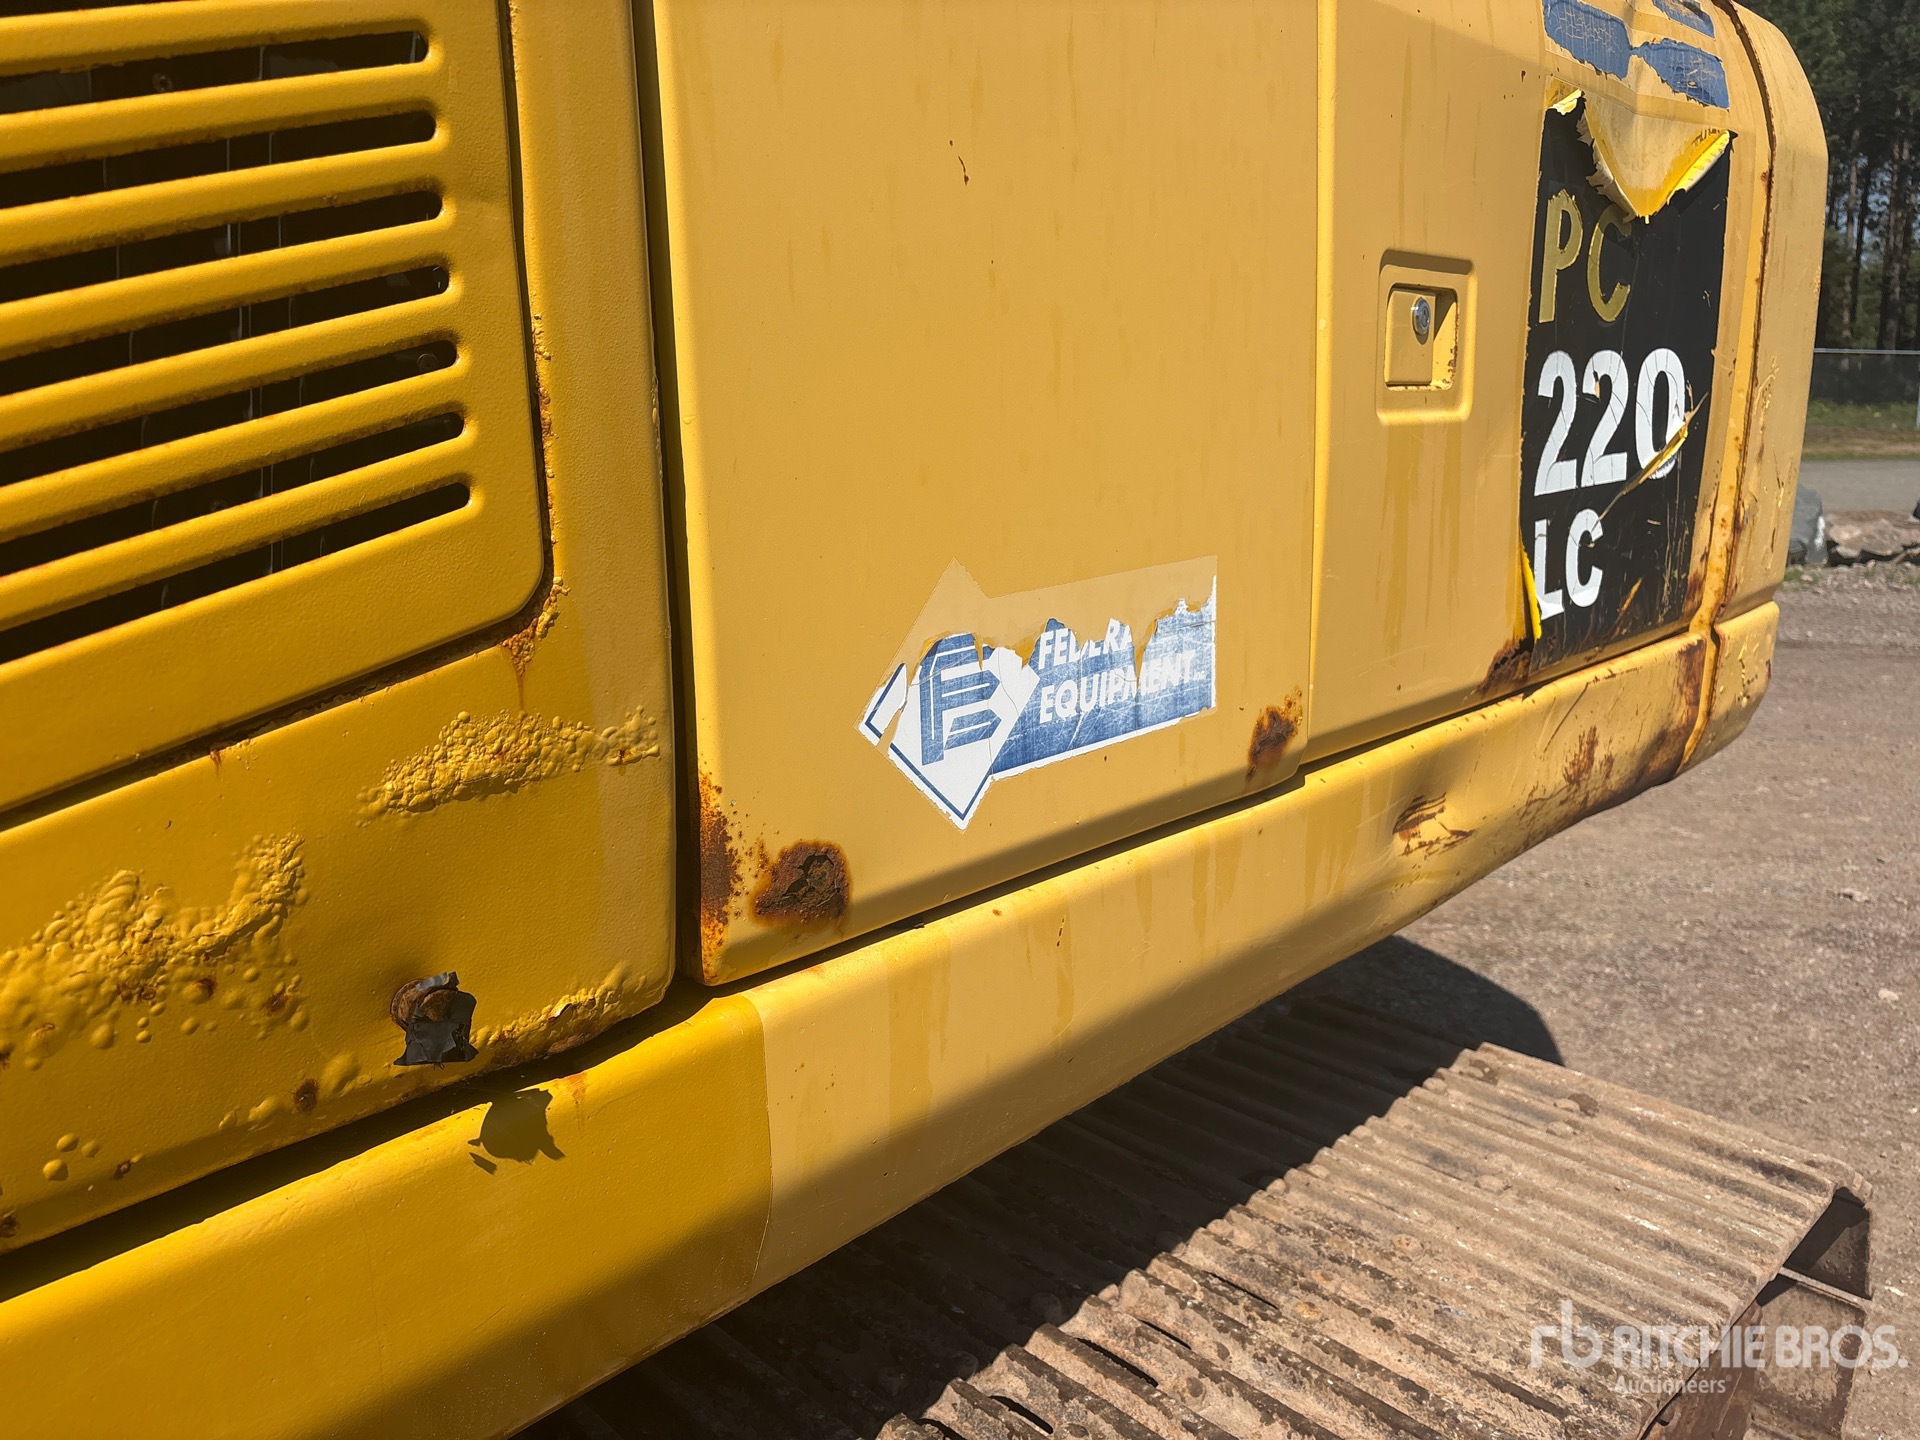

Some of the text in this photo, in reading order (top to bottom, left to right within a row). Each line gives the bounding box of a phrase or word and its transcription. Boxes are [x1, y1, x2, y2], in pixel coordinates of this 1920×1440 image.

[1538, 188, 1632, 323] PC
[1534, 347, 1688, 496] 220
[1534, 508, 1604, 621] LC
[1039, 648, 1196, 724] EQUIPMENT
